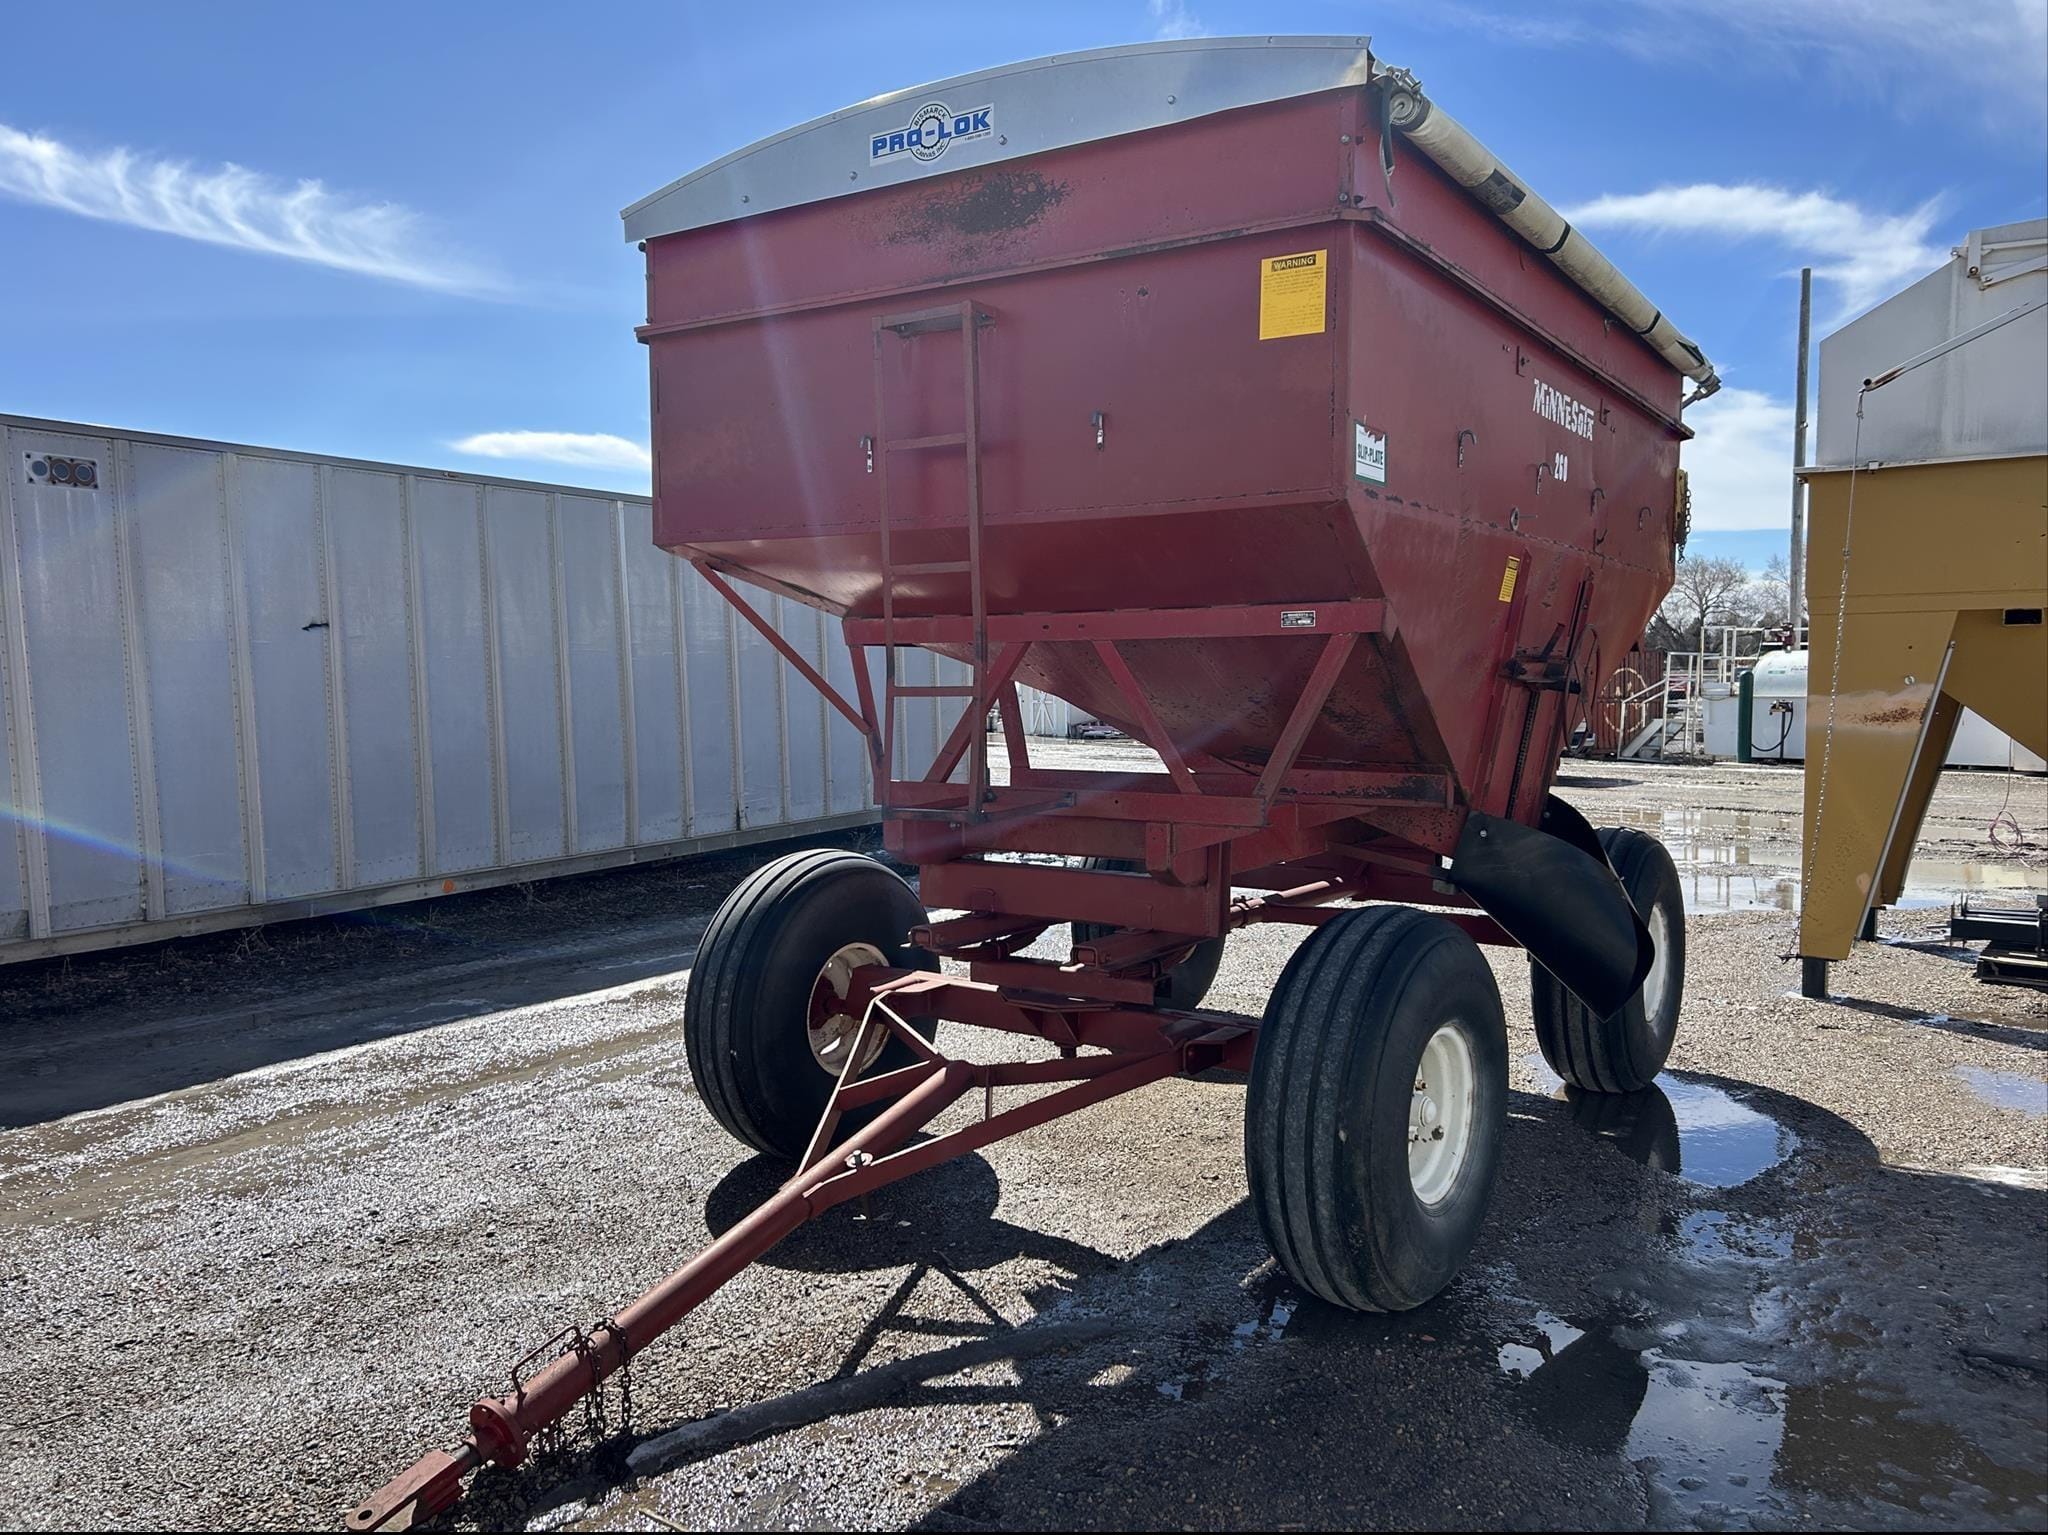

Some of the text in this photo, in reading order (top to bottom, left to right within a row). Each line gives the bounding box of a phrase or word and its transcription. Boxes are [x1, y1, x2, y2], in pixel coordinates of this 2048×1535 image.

[914, 106, 946, 127] BISMARCK
[872, 110, 990, 157] PRO-LOK
[915, 147, 937, 158] CANVAS
[1273, 255, 1315, 270] WARNING
[1532, 378, 1595, 441] MINNESOTA
[1357, 443, 1384, 466] SLIP-PLATE
